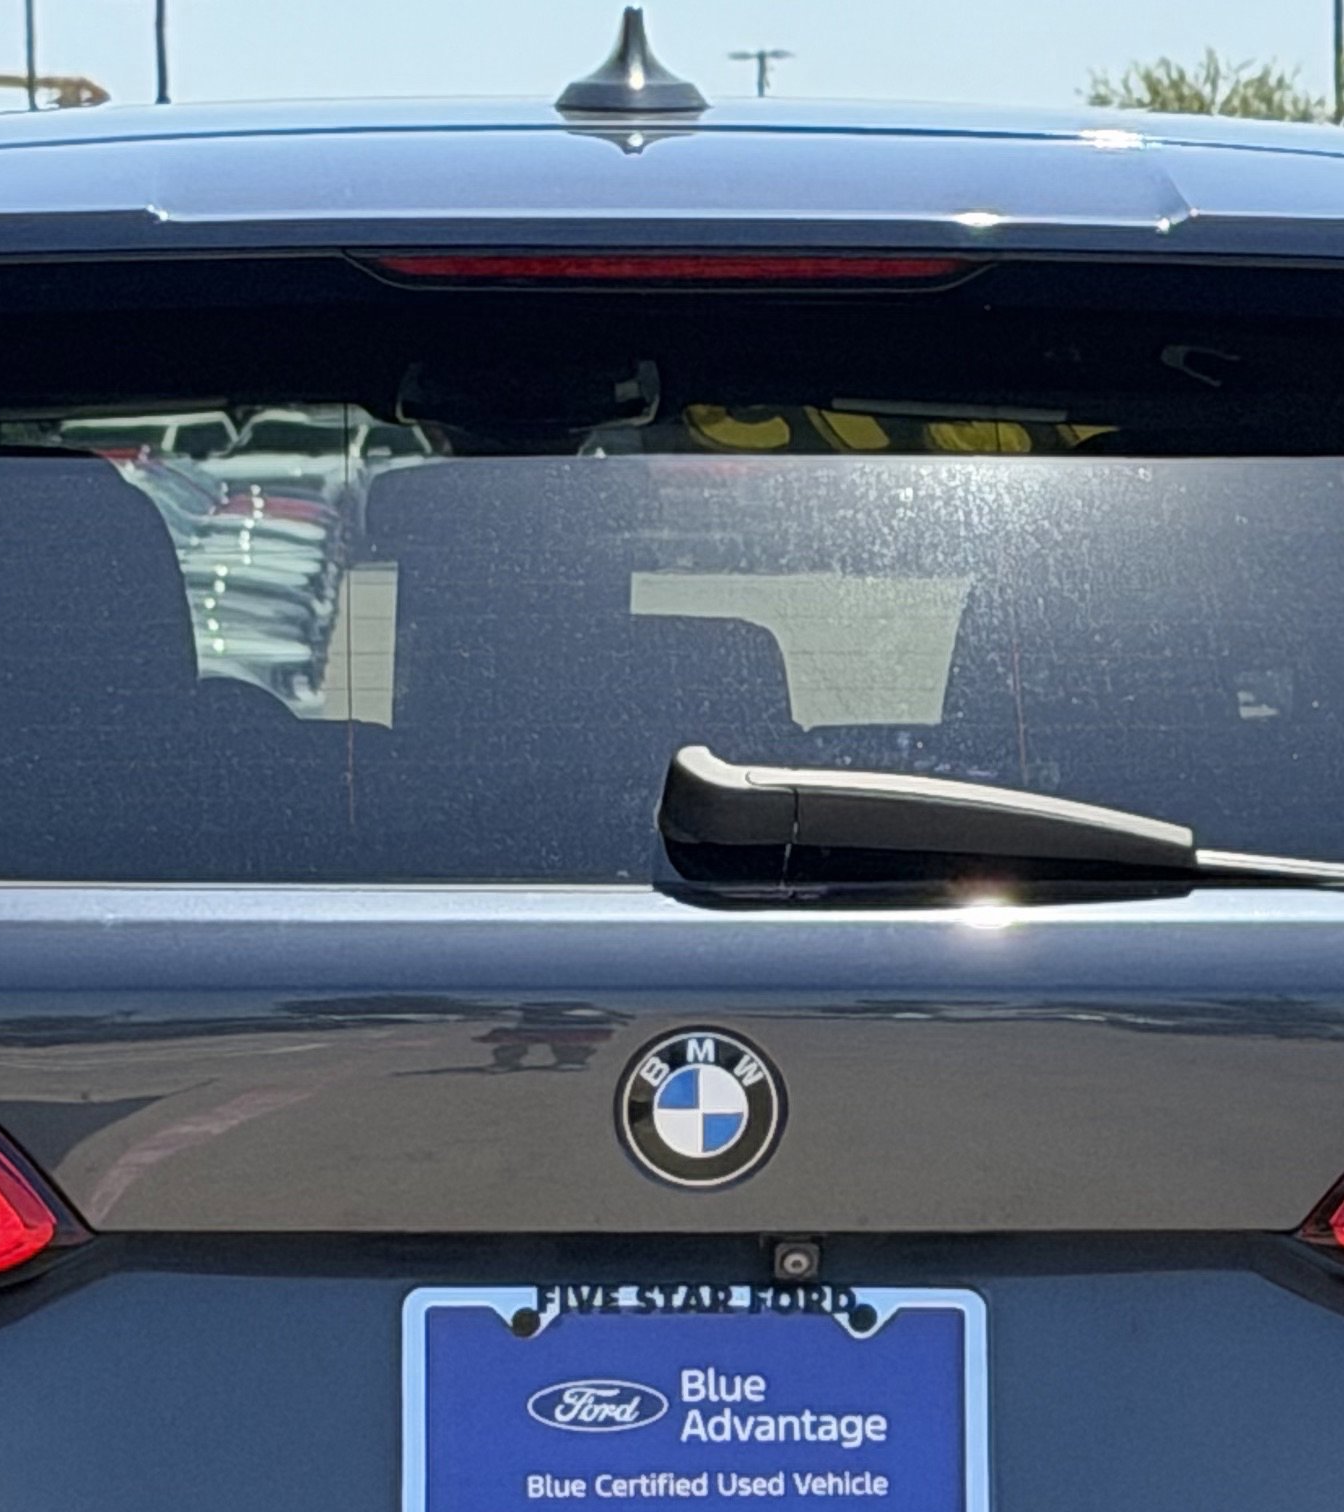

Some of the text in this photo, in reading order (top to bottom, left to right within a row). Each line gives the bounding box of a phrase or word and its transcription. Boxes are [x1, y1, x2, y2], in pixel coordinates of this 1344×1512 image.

[639, 1038, 764, 1087] BMW
[537, 1283, 856, 1313] FIVE STAR FORD
[681, 1367, 766, 1402] Blue
[554, 1388, 641, 1422] Ford
[680, 1408, 888, 1448] Advantage
[527, 1471, 889, 1498] Blue Certified Used Vehicle
